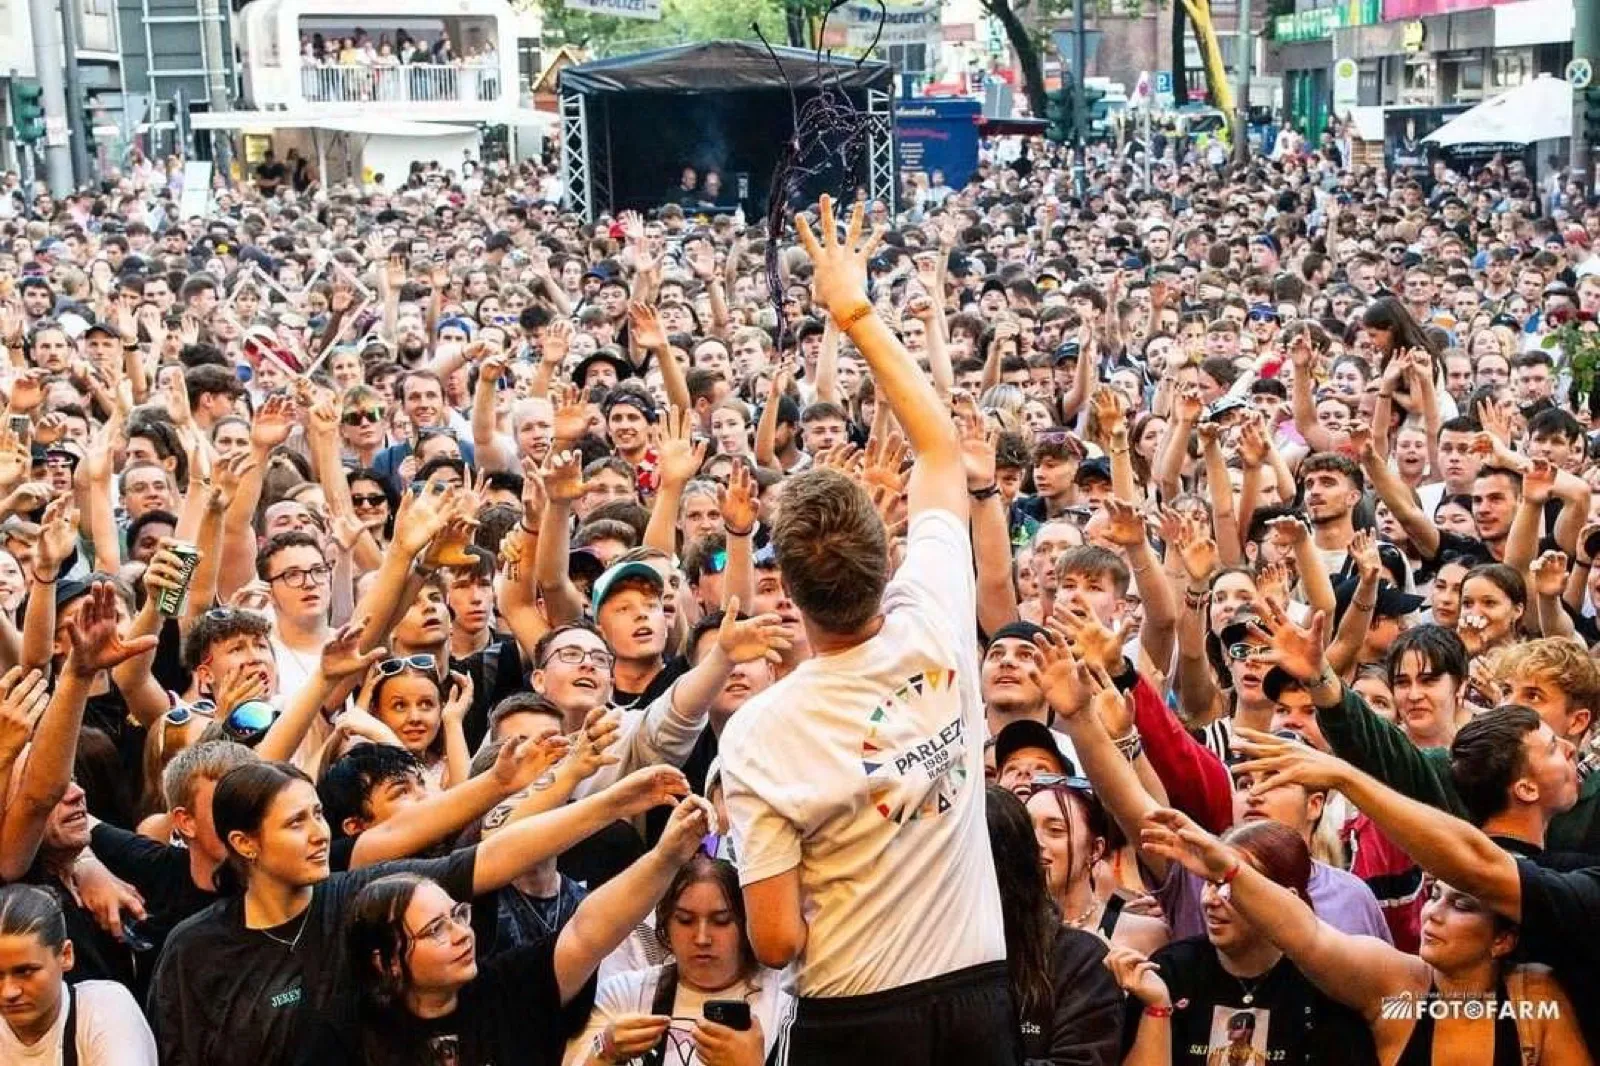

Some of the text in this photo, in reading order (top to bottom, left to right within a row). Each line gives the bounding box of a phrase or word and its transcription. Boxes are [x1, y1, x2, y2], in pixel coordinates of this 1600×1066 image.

[1157, 74, 1167, 91] P
[895, 717, 962, 776] PARLEZ
[923, 749, 949, 771] 1989
